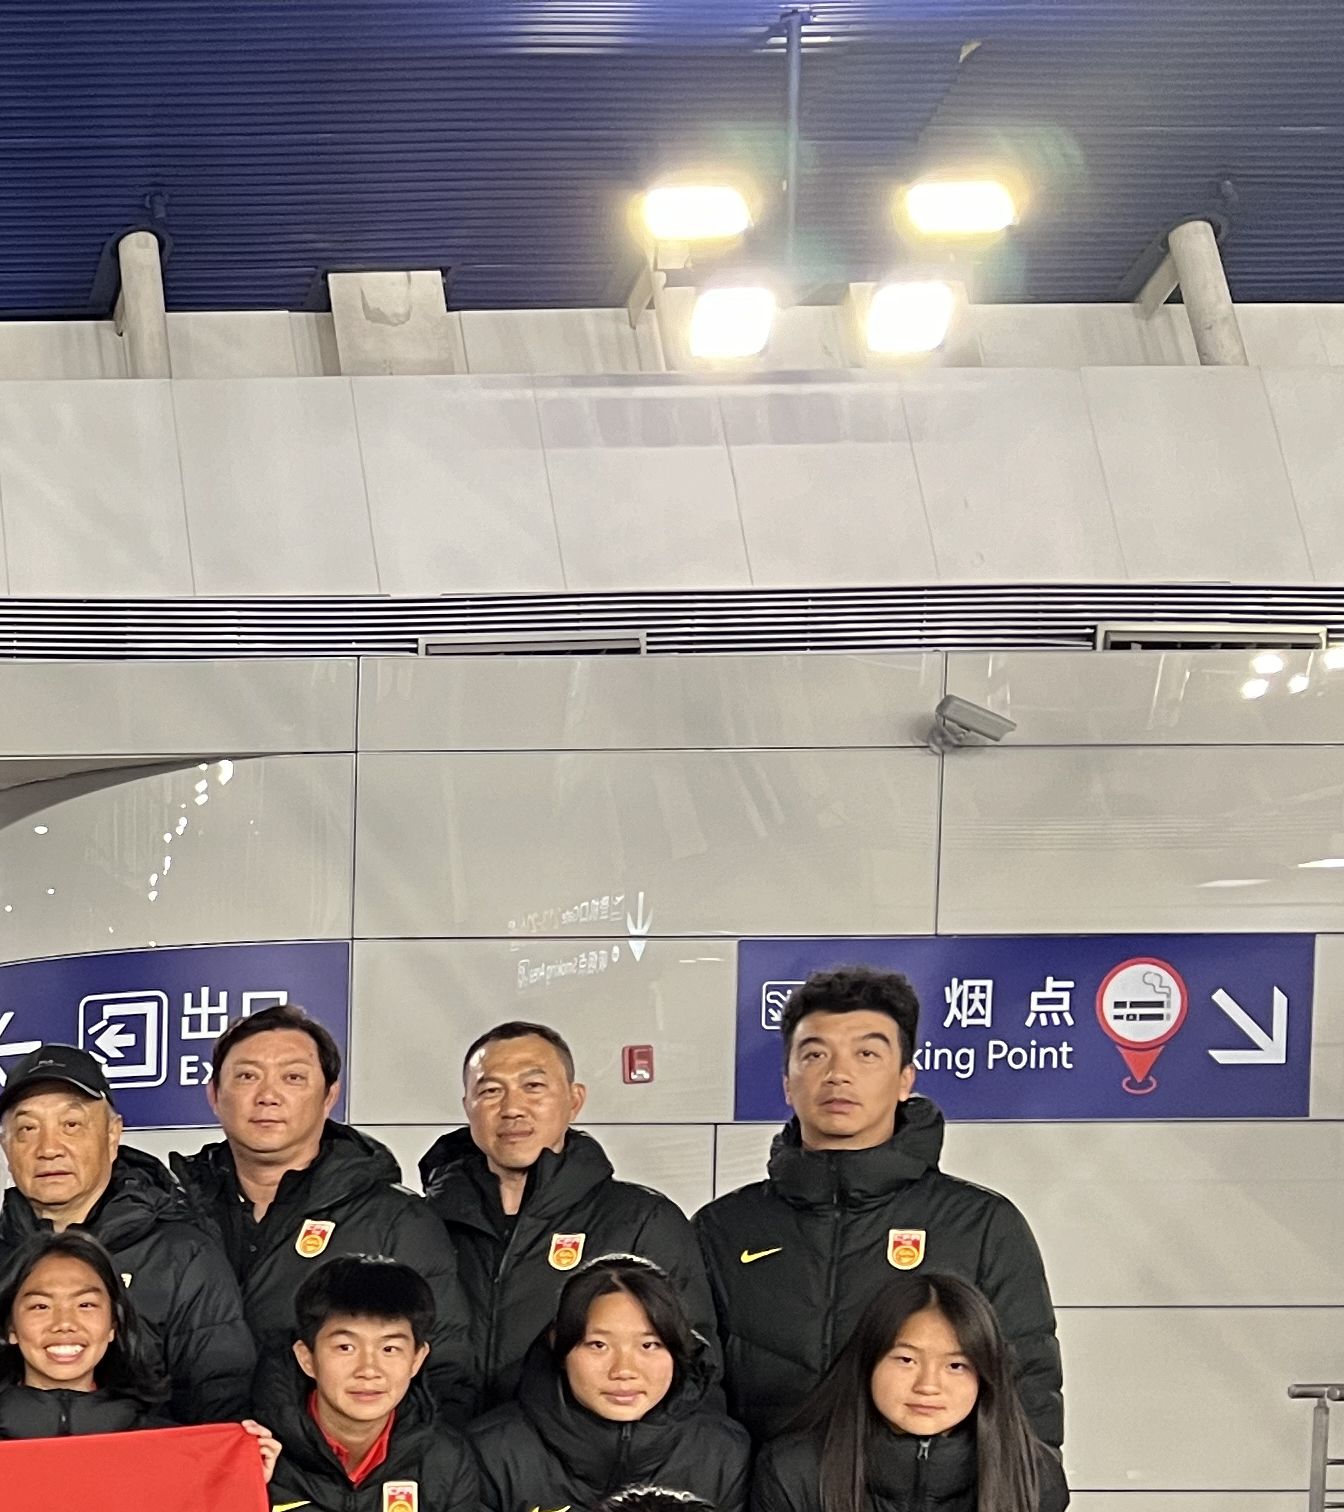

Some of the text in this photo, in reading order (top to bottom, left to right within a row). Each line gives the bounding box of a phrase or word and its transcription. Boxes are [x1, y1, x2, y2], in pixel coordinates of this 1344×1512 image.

[943, 976, 1075, 1028] 烟点
[180, 1055, 214, 1085] Ex
[987, 1040, 1074, 1070] Point
